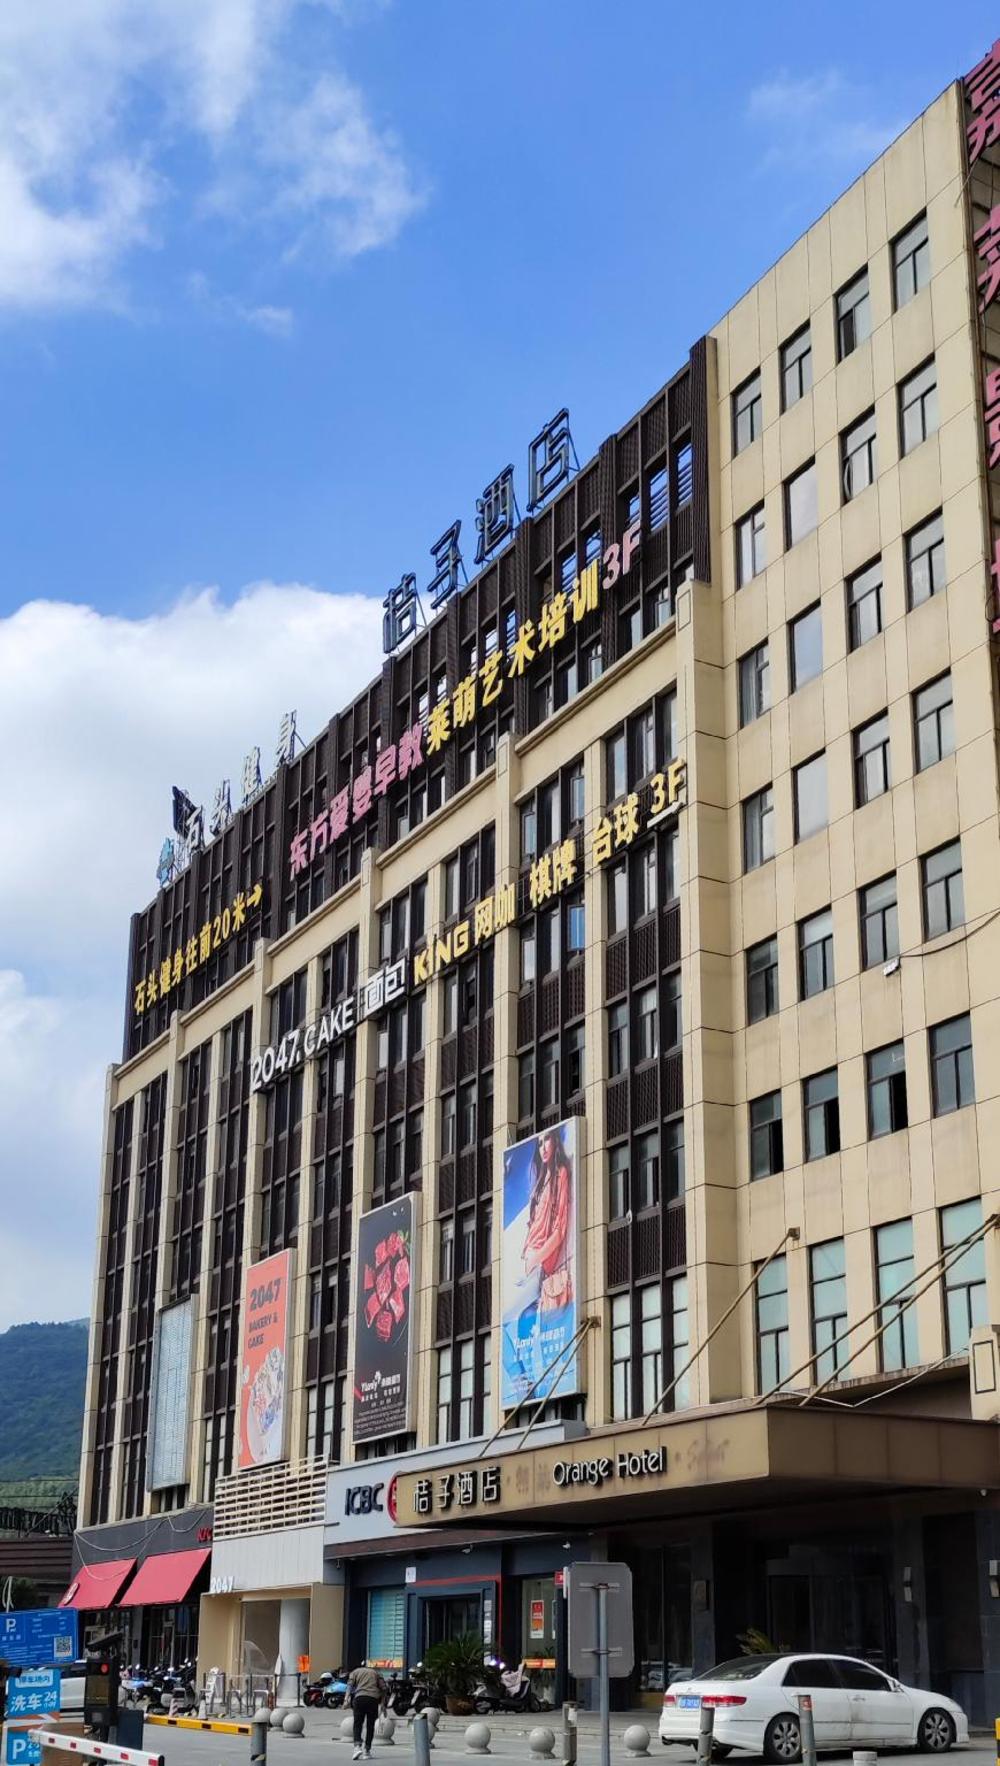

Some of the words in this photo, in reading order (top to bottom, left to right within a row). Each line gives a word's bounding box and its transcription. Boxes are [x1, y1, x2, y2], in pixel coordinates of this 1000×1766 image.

[383, 408, 569, 653] 桔子酒店
[651, 757, 687, 813] 3F
[304, 996, 354, 1056] CAKE
[250, 1279, 281, 1312] 2047
[553, 1457, 610, 1486] Orange
[617, 1446, 666, 1477] Hotel
[345, 1483, 384, 1516] ICBC
[413, 1466, 499, 1513] 桔子酒店
[10, 1693, 42, 1712] 洗车
[12, 1739, 26, 1760] P
